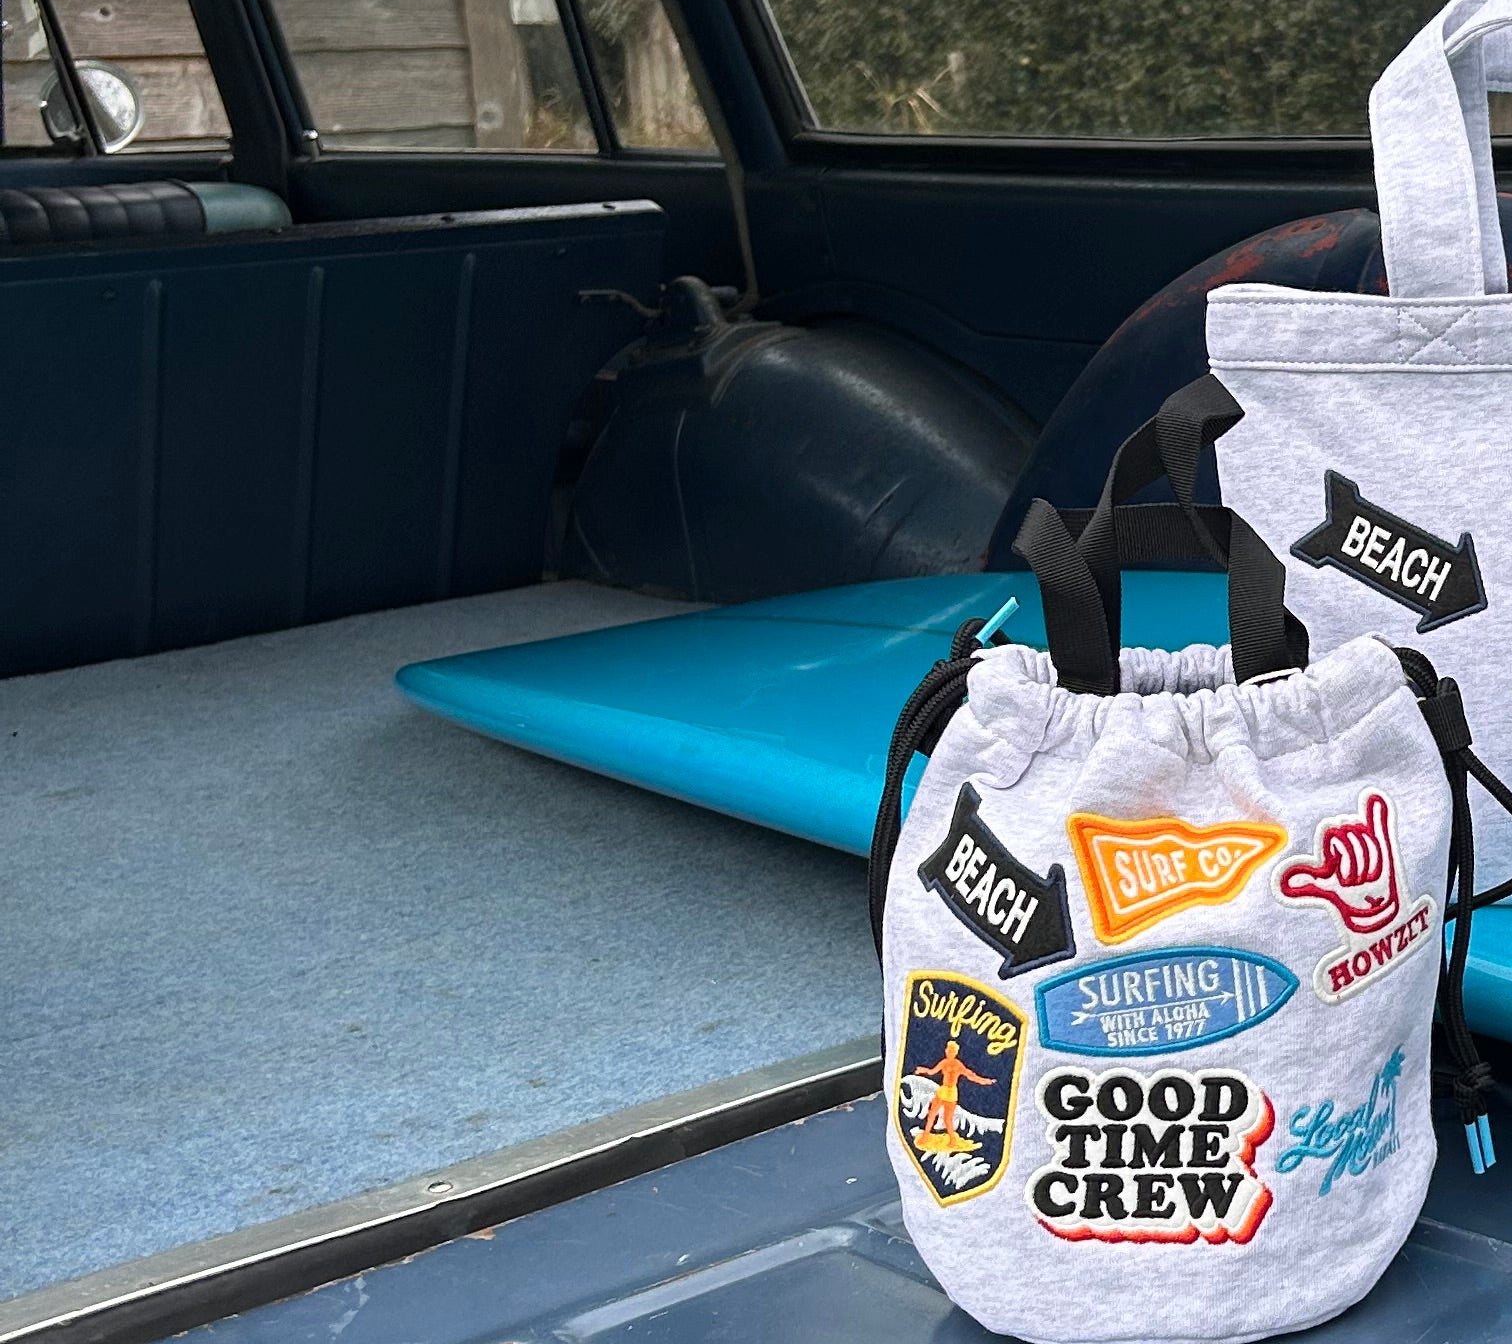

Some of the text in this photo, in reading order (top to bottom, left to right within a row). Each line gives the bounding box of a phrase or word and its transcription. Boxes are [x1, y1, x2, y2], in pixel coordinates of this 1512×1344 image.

[1341, 516, 1451, 601] BEACH
[945, 834, 1039, 944] BEACH
[1115, 849, 1187, 898] SURF
[1328, 906, 1429, 992] HOWZIT
[1079, 959, 1220, 1010] SURFING
[914, 980, 1017, 1055] Surfing
[1100, 1002, 1210, 1033] WITH ALOHA
[1107, 1019, 1206, 1047] SINCE 1977
[1044, 1075, 1248, 1121] GOOD
[1055, 1124, 1230, 1168] TIME
[1034, 1171, 1244, 1220] CREW
